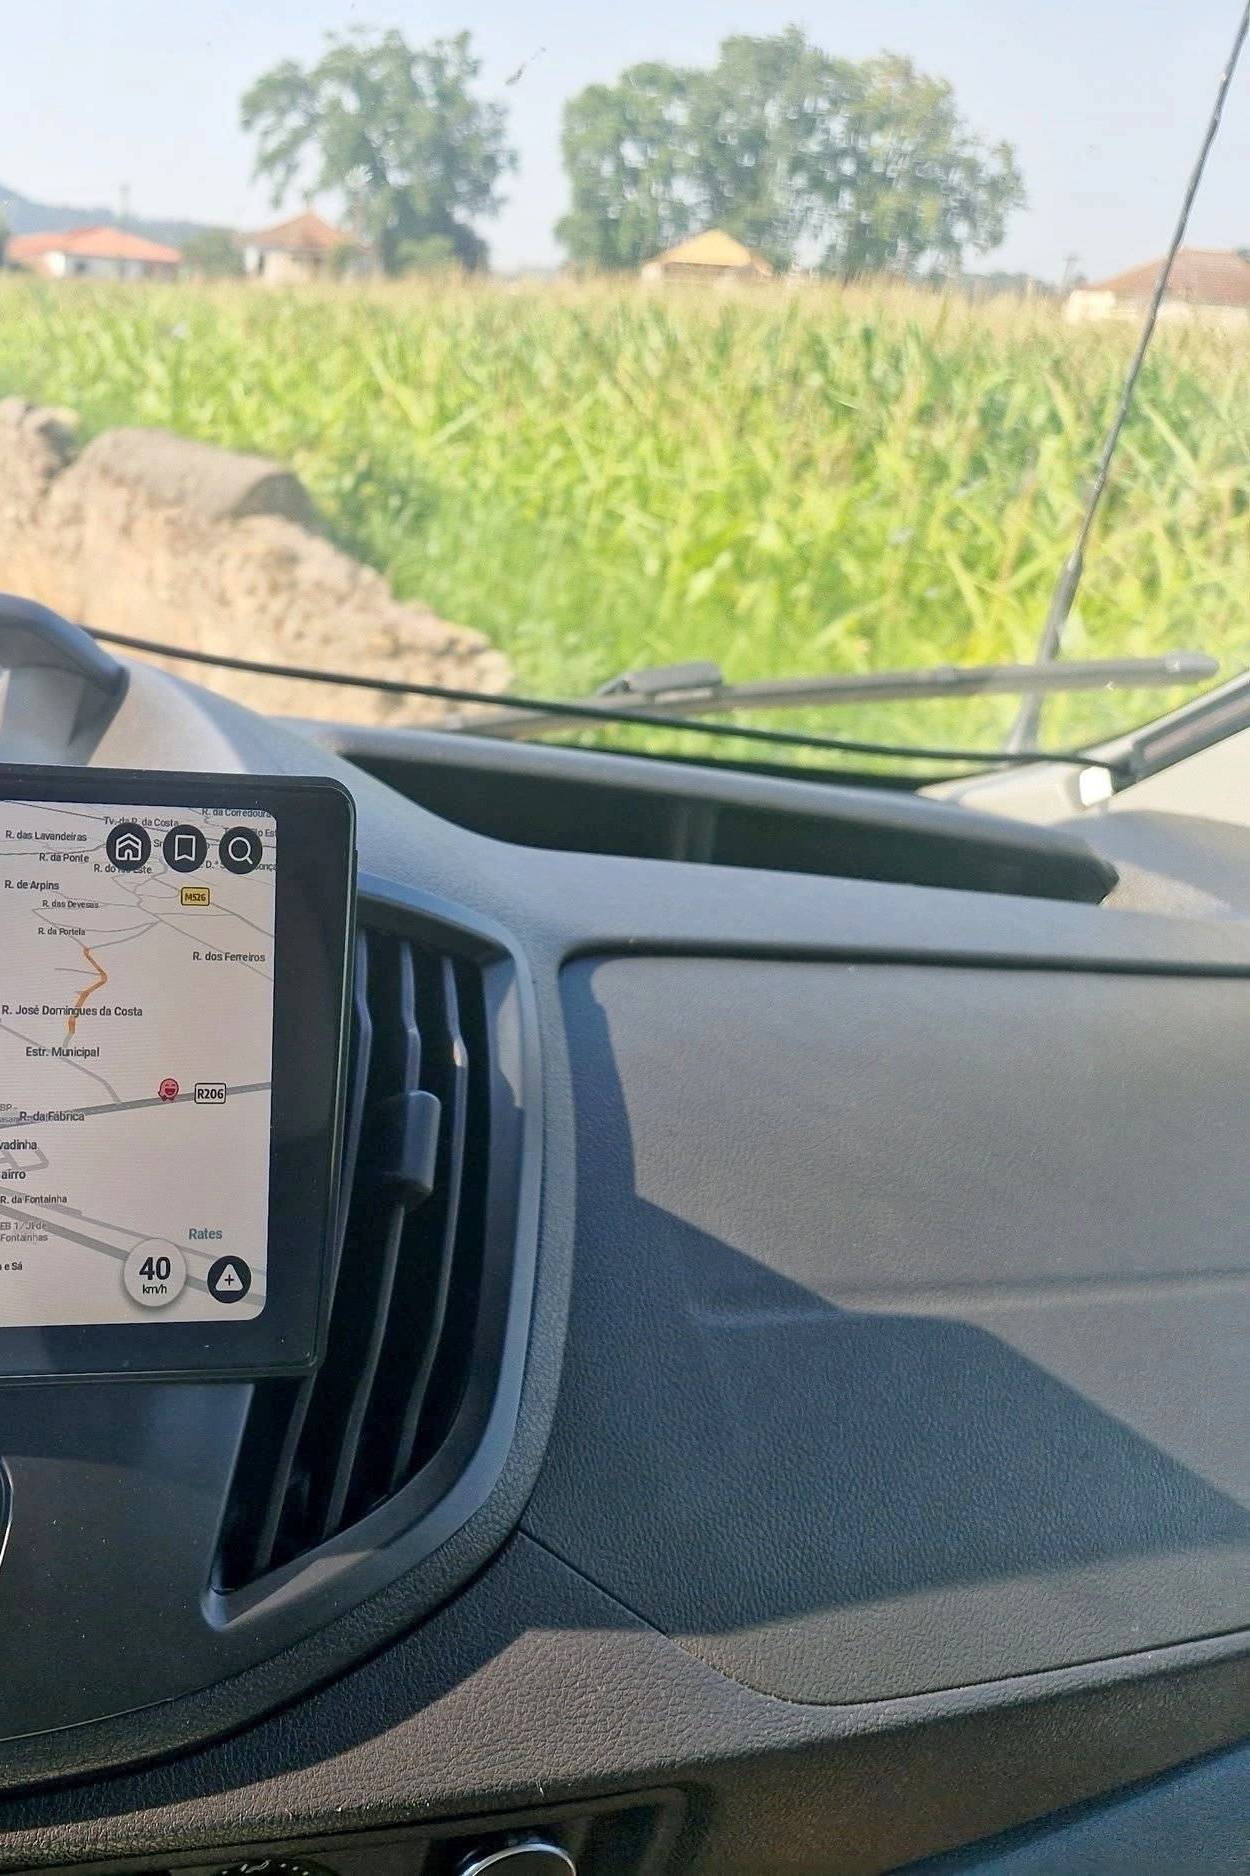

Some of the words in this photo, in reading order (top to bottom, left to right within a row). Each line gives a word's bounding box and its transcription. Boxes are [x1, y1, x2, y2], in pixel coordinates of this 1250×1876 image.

[154, 817, 179, 827] Costa
[6, 830, 15, 838] R.
[17, 830, 32, 839] das
[35, 832, 87, 841] Lavandeiras
[39, 853, 48, 861] R.
[50, 853, 61, 862] da
[63, 854, 89, 862] Ponte
[94, 863, 103, 873] R.
[5, 880, 14, 889] R.
[17, 880, 28, 889] de
[30, 880, 59, 892] Arpins
[185, 893, 206, 901] M526
[52, 899, 65, 907] das
[68, 900, 98, 908] Devesas
[38, 927, 45, 935] R.
[48, 927, 57, 935] da
[59, 927, 85, 936] Portela
[193, 952, 203, 961] R.
[205, 952, 222, 962] dos
[224, 952, 265, 962] Ferreiros
[2, 1005, 13, 1015] R.
[16, 1005, 40, 1016] José
[42, 1006, 97, 1018] Domingues
[100, 1006, 112, 1016] da
[114, 1006, 142, 1017] Costa
[26, 1047, 49, 1057] Estr.
[51, 1047, 99, 1059] Municipal
[197, 1088, 224, 1099] R206
[19, 1111, 30, 1121] R.
[33, 1111, 46, 1121] da
[48, 1111, 85, 1122] Fábrica
[0, 1196, 10, 1204] R.
[12, 1195, 22, 1203] da
[25, 1195, 67, 1203] Fontainha
[189, 1228, 222, 1239] Rates
[12, 1261, 22, 1270] Sá
[139, 1257, 171, 1280] 40
[142, 1284, 167, 1294] km/h
